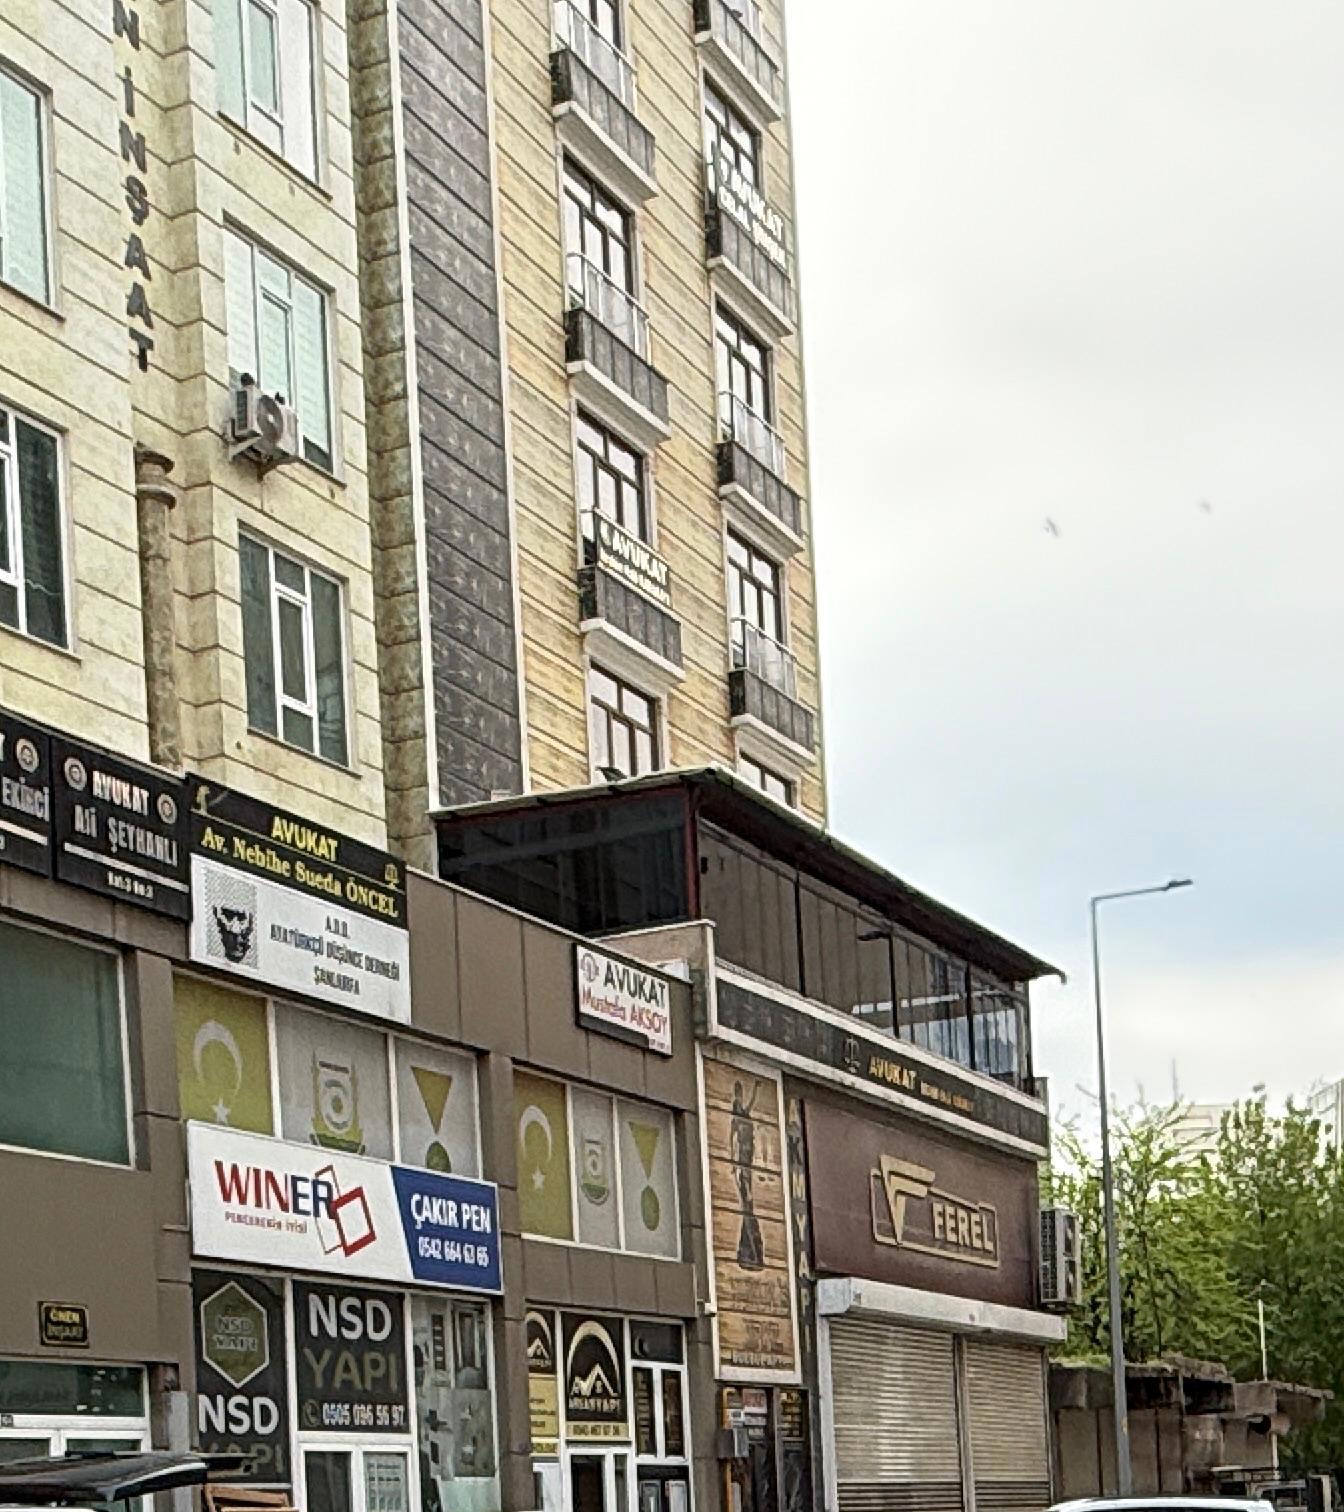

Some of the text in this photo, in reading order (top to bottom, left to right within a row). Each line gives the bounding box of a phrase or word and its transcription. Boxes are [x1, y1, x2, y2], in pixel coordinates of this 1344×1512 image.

[93, 770, 149, 816] AVUKAT
[271, 815, 338, 862] AVUKAT
[201, 826, 229, 855] Av.
[346, 876, 400, 918] ÖNCEL
[603, 959, 666, 1009] AVUKAT
[214, 1160, 337, 1220] WINER
[410, 1193, 492, 1235] ÇAKIR PEN
[931, 1202, 995, 1254] FEREL
[309, 1293, 392, 1341] NSD
[303, 1347, 398, 1392] YAPI
[198, 1395, 279, 1435] NSD
